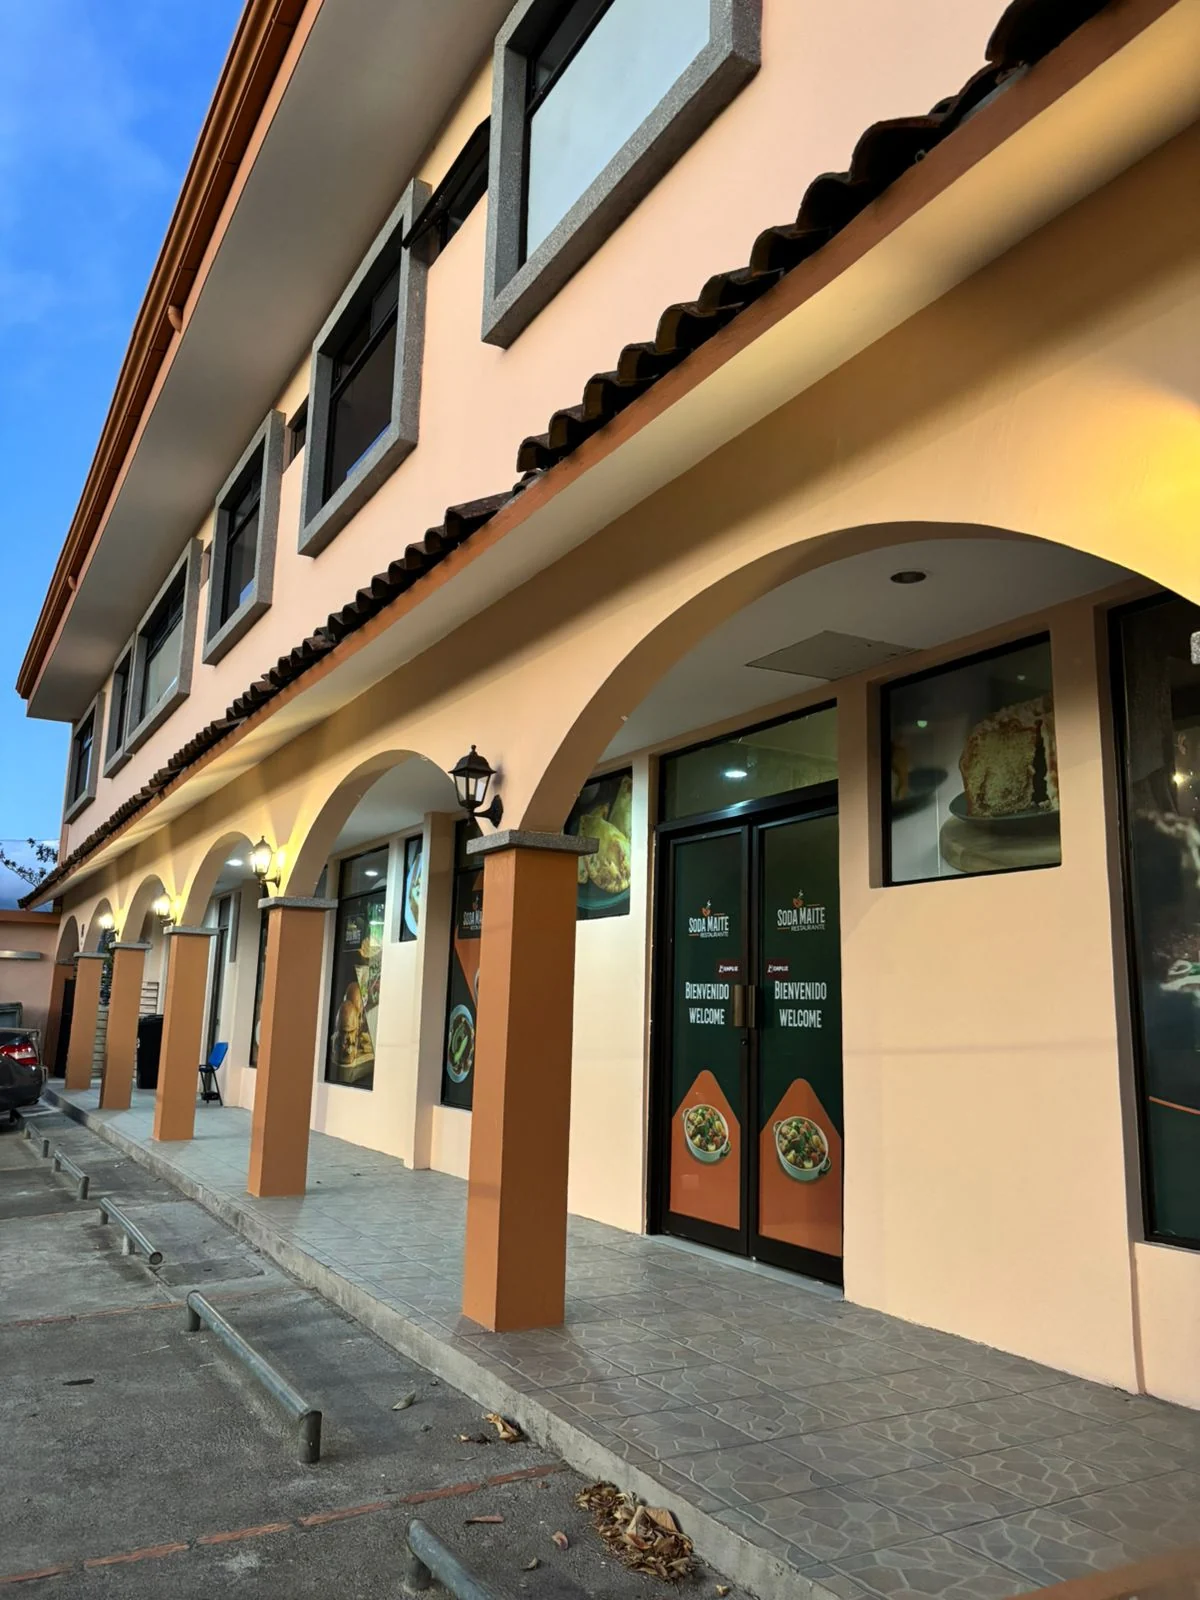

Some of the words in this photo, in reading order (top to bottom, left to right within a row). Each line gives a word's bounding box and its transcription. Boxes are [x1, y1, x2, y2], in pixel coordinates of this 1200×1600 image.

[688, 917, 706, 933] SODA
[707, 915, 729, 932] MAITE
[776, 909, 798, 927] SODA
[799, 906, 826, 925] MAITE
[790, 924, 825, 932] RESTAURANTE
[685, 982, 730, 1000] BIENVENIDO
[774, 981, 827, 1001] BIENVENIDO
[689, 1007, 726, 1025] WELCOME
[779, 1009, 822, 1028] WELCOME
